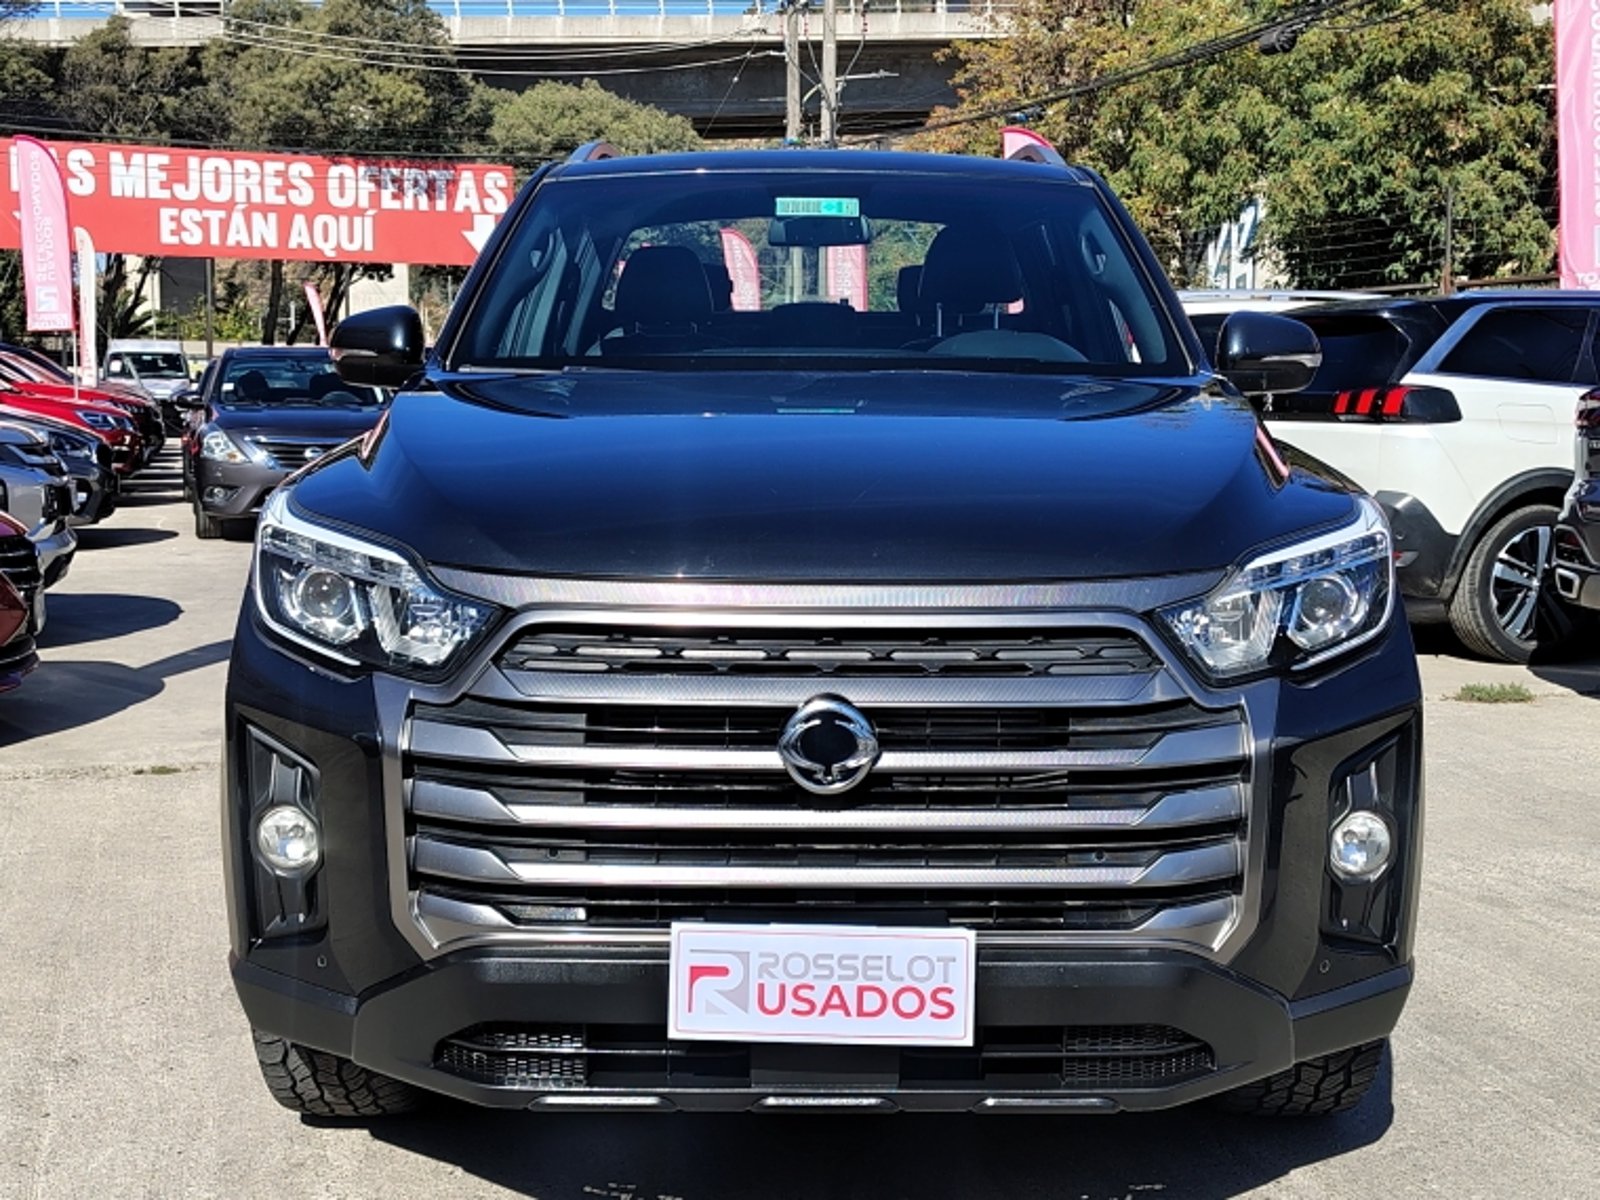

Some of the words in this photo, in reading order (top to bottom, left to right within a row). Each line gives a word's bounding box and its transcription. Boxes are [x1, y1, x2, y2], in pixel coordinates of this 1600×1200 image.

[109, 151, 315, 207] MEJORES
[327, 163, 509, 213] OFERTAS
[159, 203, 281, 249] ESTÁN
[290, 209, 377, 257] AQUÍ
[757, 951, 956, 983] ROSSELOT
[757, 982, 955, 1019] USADOS
